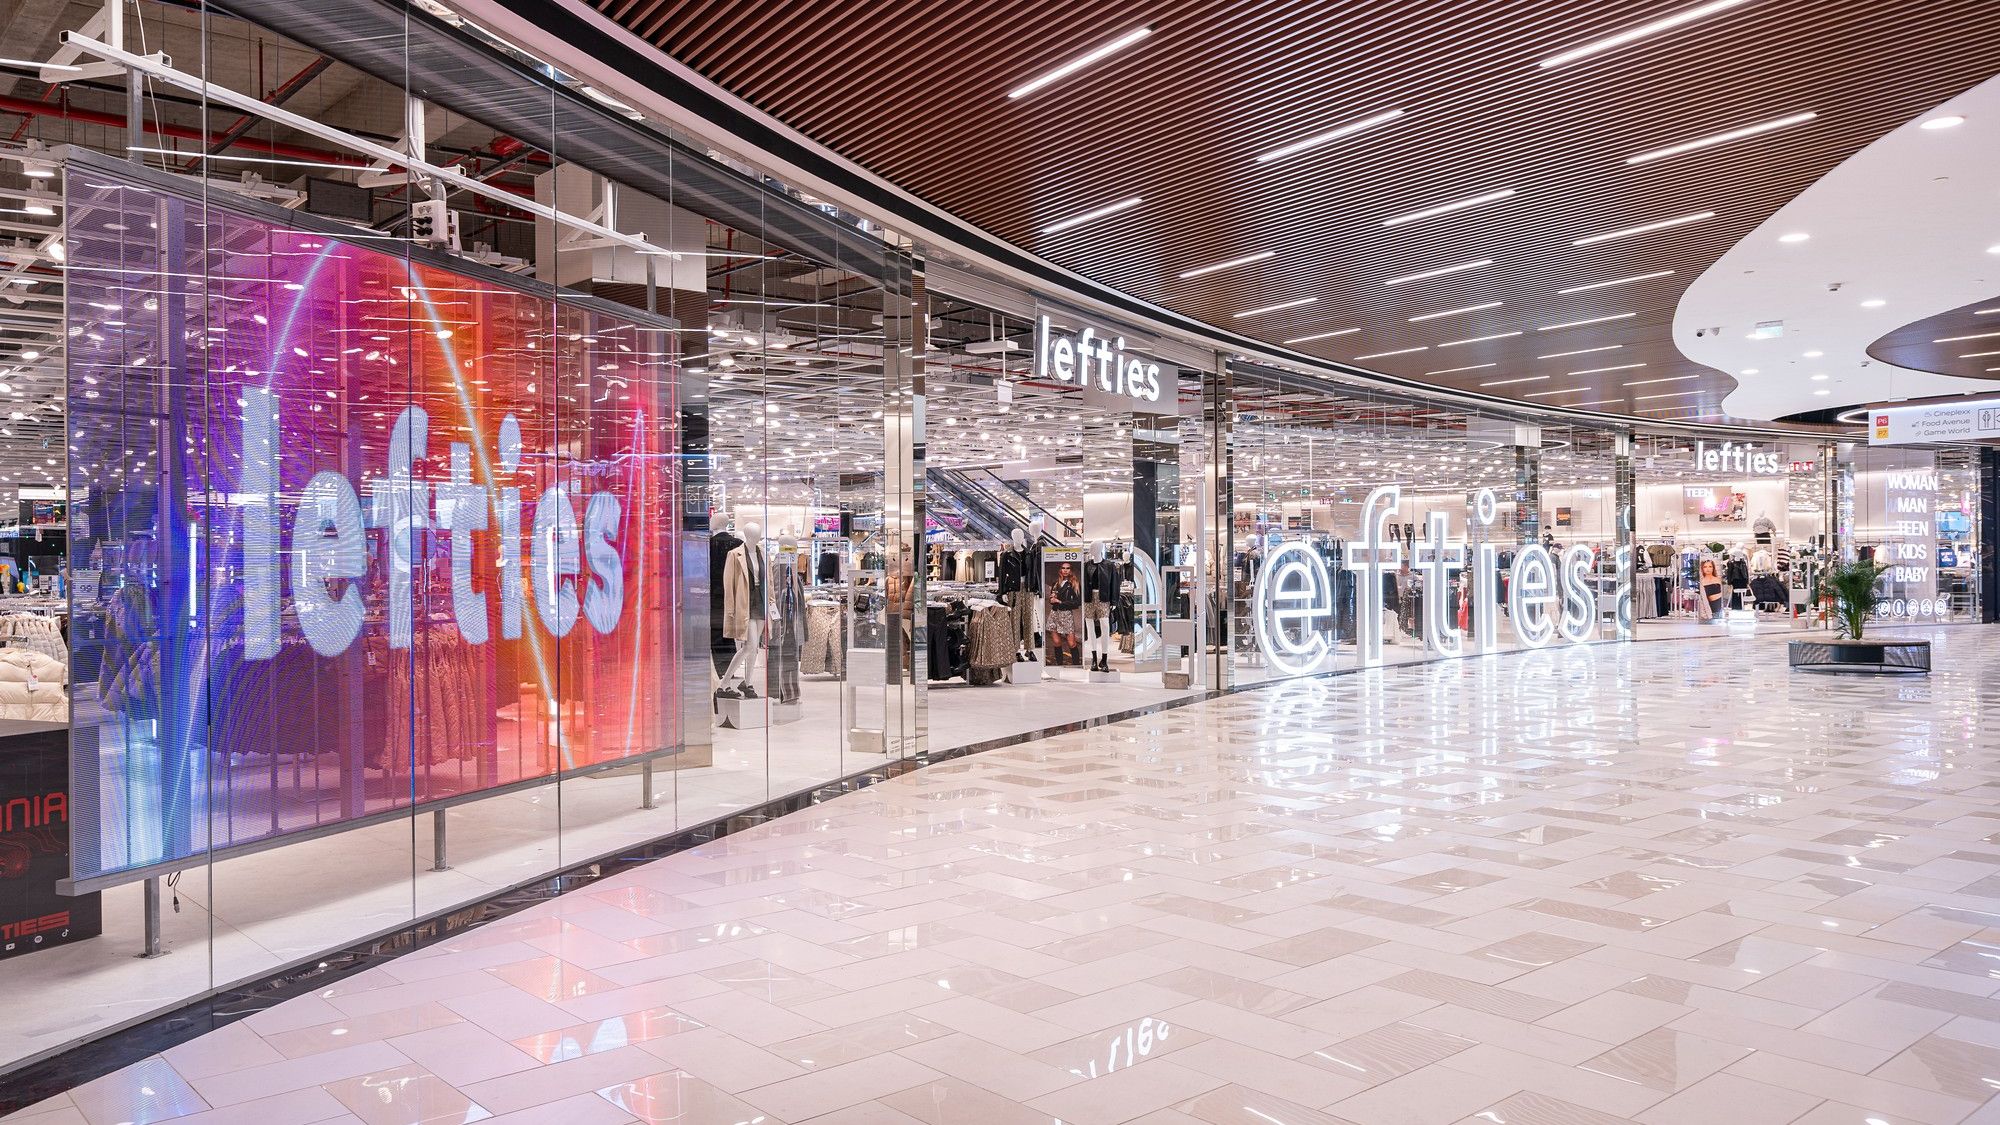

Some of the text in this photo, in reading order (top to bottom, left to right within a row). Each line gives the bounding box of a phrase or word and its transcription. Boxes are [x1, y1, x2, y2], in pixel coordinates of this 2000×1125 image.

[1040, 314, 1160, 401] lefties
[1933, 409, 1971, 417] Cineplexx
[1696, 440, 1779, 474] lefties
[1887, 474, 1938, 491] WOMAN
[1897, 497, 1927, 514] MAN
[241, 385, 624, 661] lefties
[1896, 520, 1929, 536] TEEN
[1064, 552, 1078, 560] 89
[1897, 543, 1927, 560] KIDS
[1895, 566, 1929, 583] BABY
[0, 792, 68, 832] NIA
